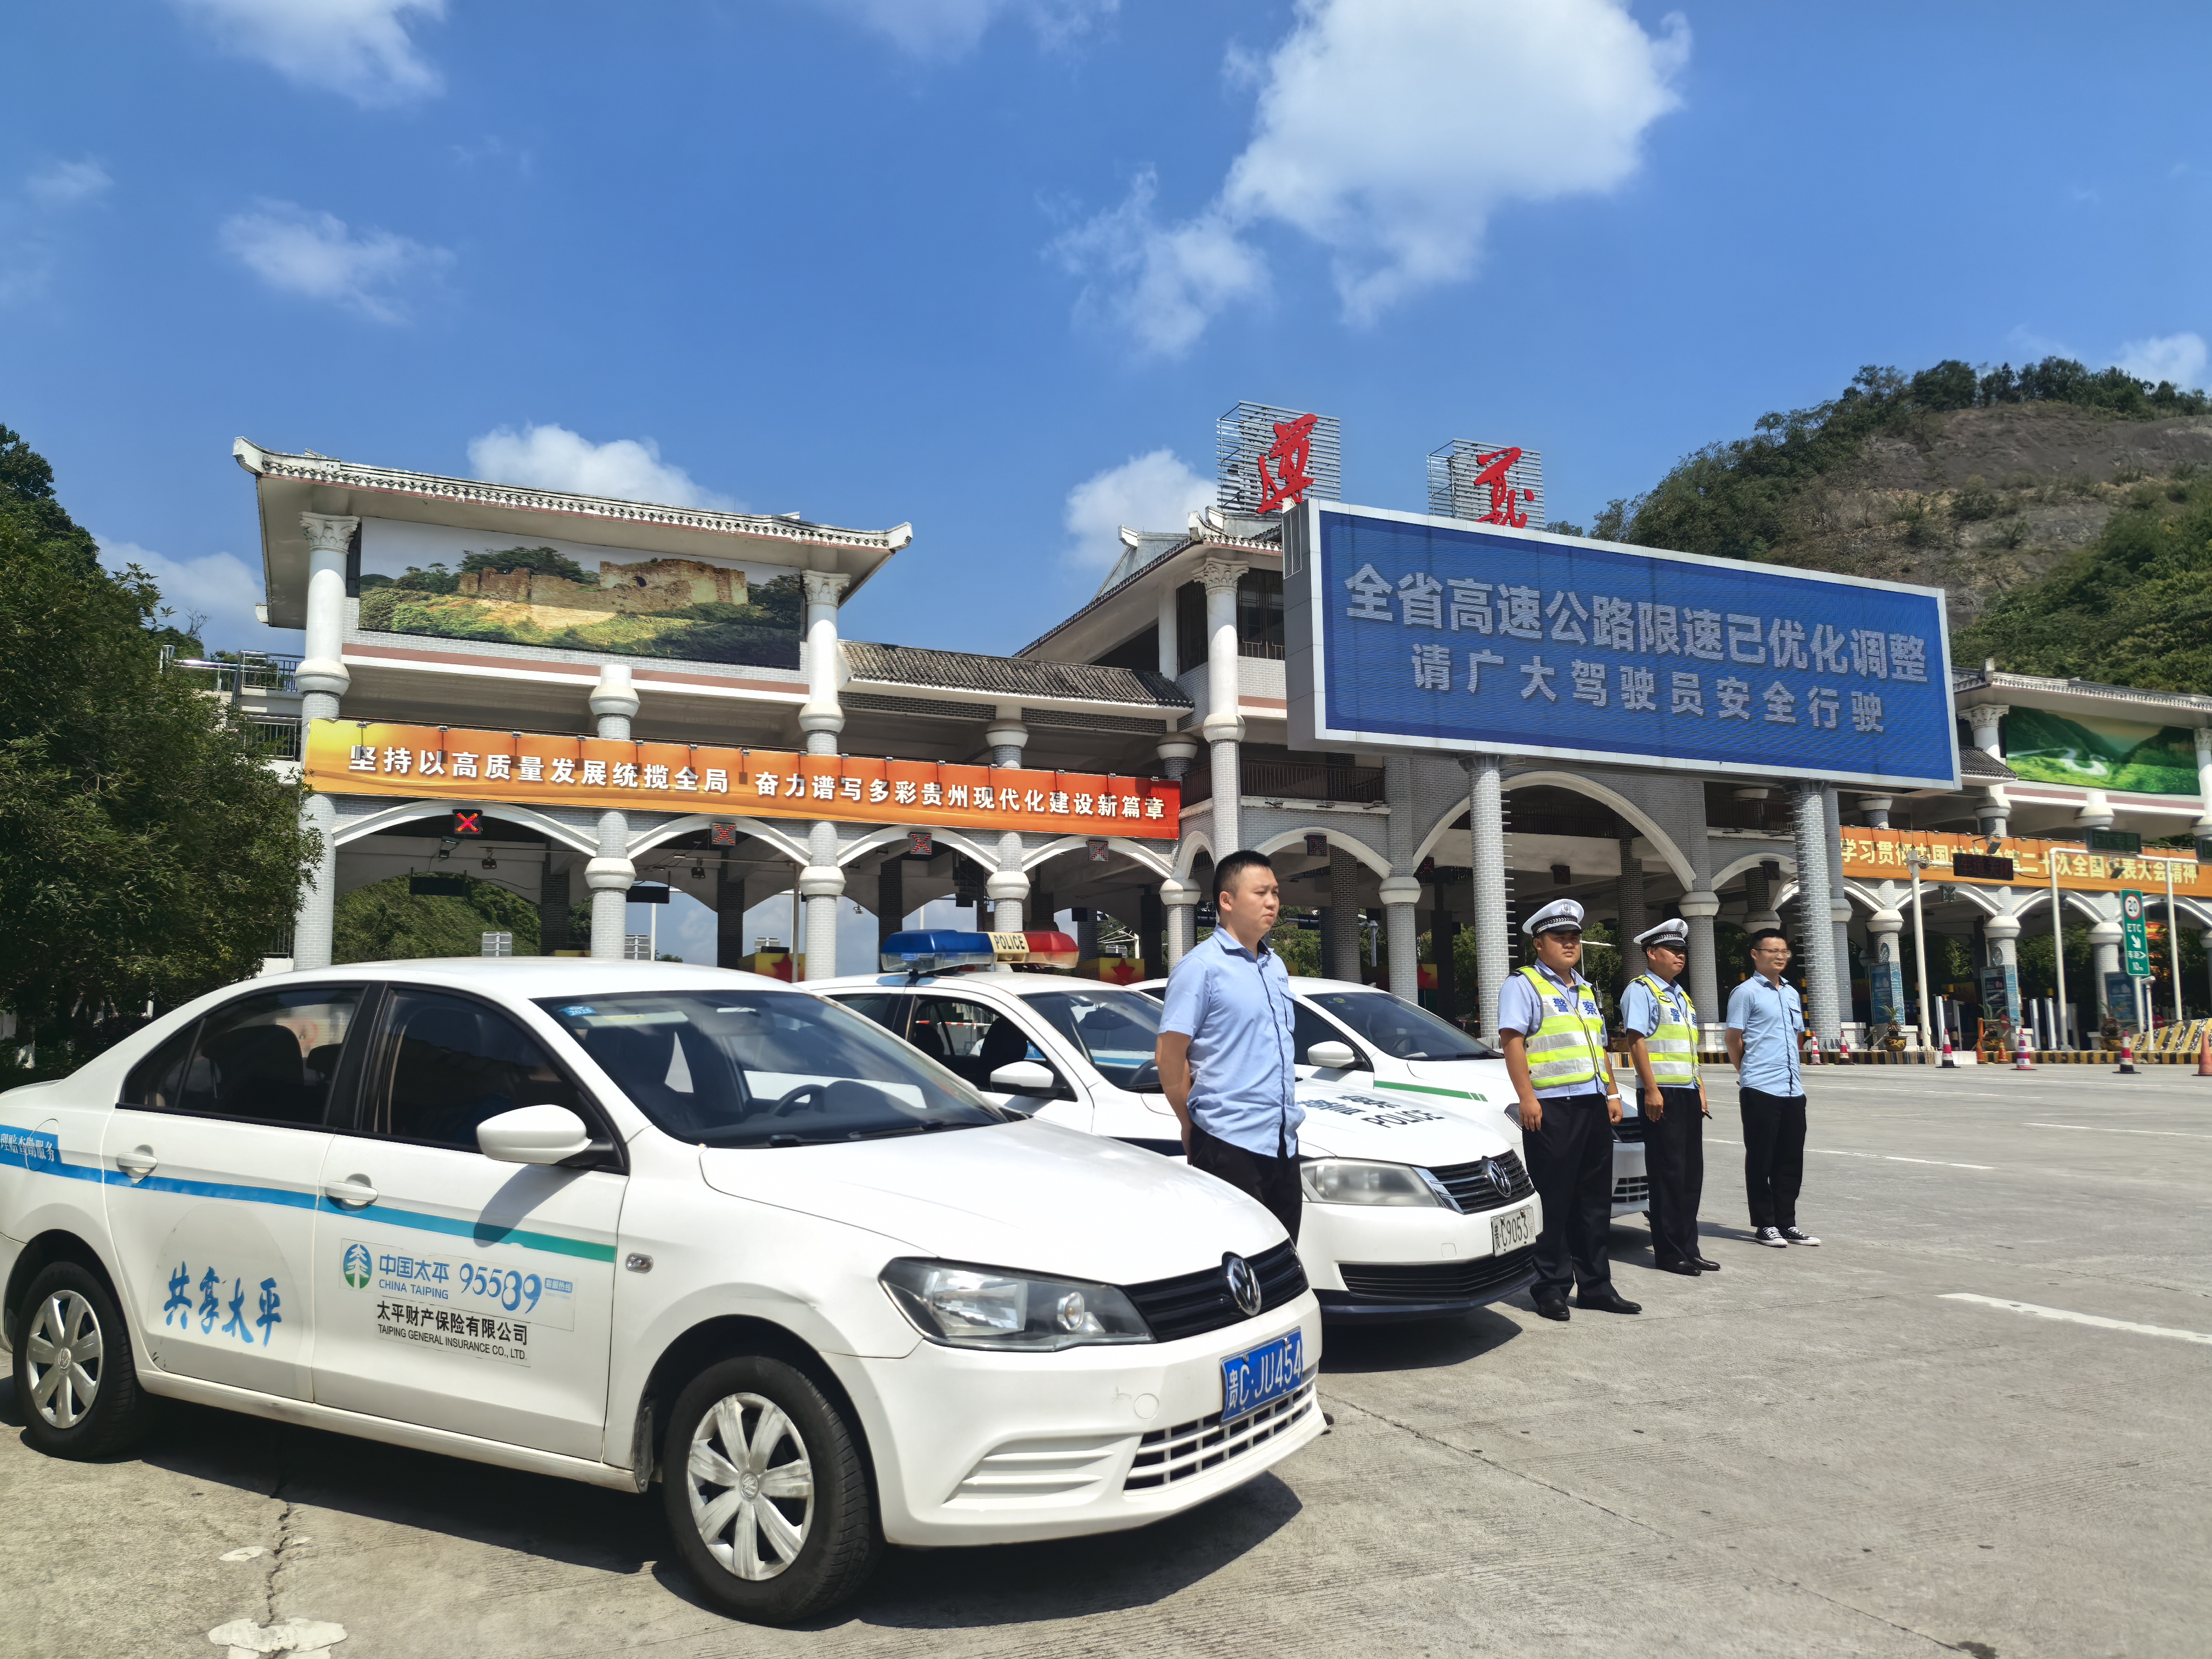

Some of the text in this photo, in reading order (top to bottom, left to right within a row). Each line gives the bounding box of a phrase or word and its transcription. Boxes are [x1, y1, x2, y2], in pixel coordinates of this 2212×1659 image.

[1344, 564, 1928, 682] 全省高速公路限速已优化调整
[1412, 644, 1883, 733] 请广大驾驶员安全行驶
[348, 745, 1165, 820] 坚持以高质量发展统揽全局 奋力谱写多彩贵州现代化建设新篇章
[2128, 900, 2137, 912] 20
[2127, 923, 2142, 933] ETC
[994, 934, 1025, 950] POLICE
[1553, 998, 1597, 1015] 警察
[1361, 1110, 1446, 1128] POLICE
[379, 1254, 450, 1284] 中国太平
[460, 1263, 542, 1314] 95589
[379, 1279, 448, 1299] CHINA TAIPING
[377, 1300, 527, 1345] 太平财产保险有限公司
[378, 1324, 406, 1338] TAIPING
[408, 1330, 443, 1345] GENERAL
[446, 1336, 490, 1353] INSURANCE
[493, 1345, 508, 1358] CO.,
